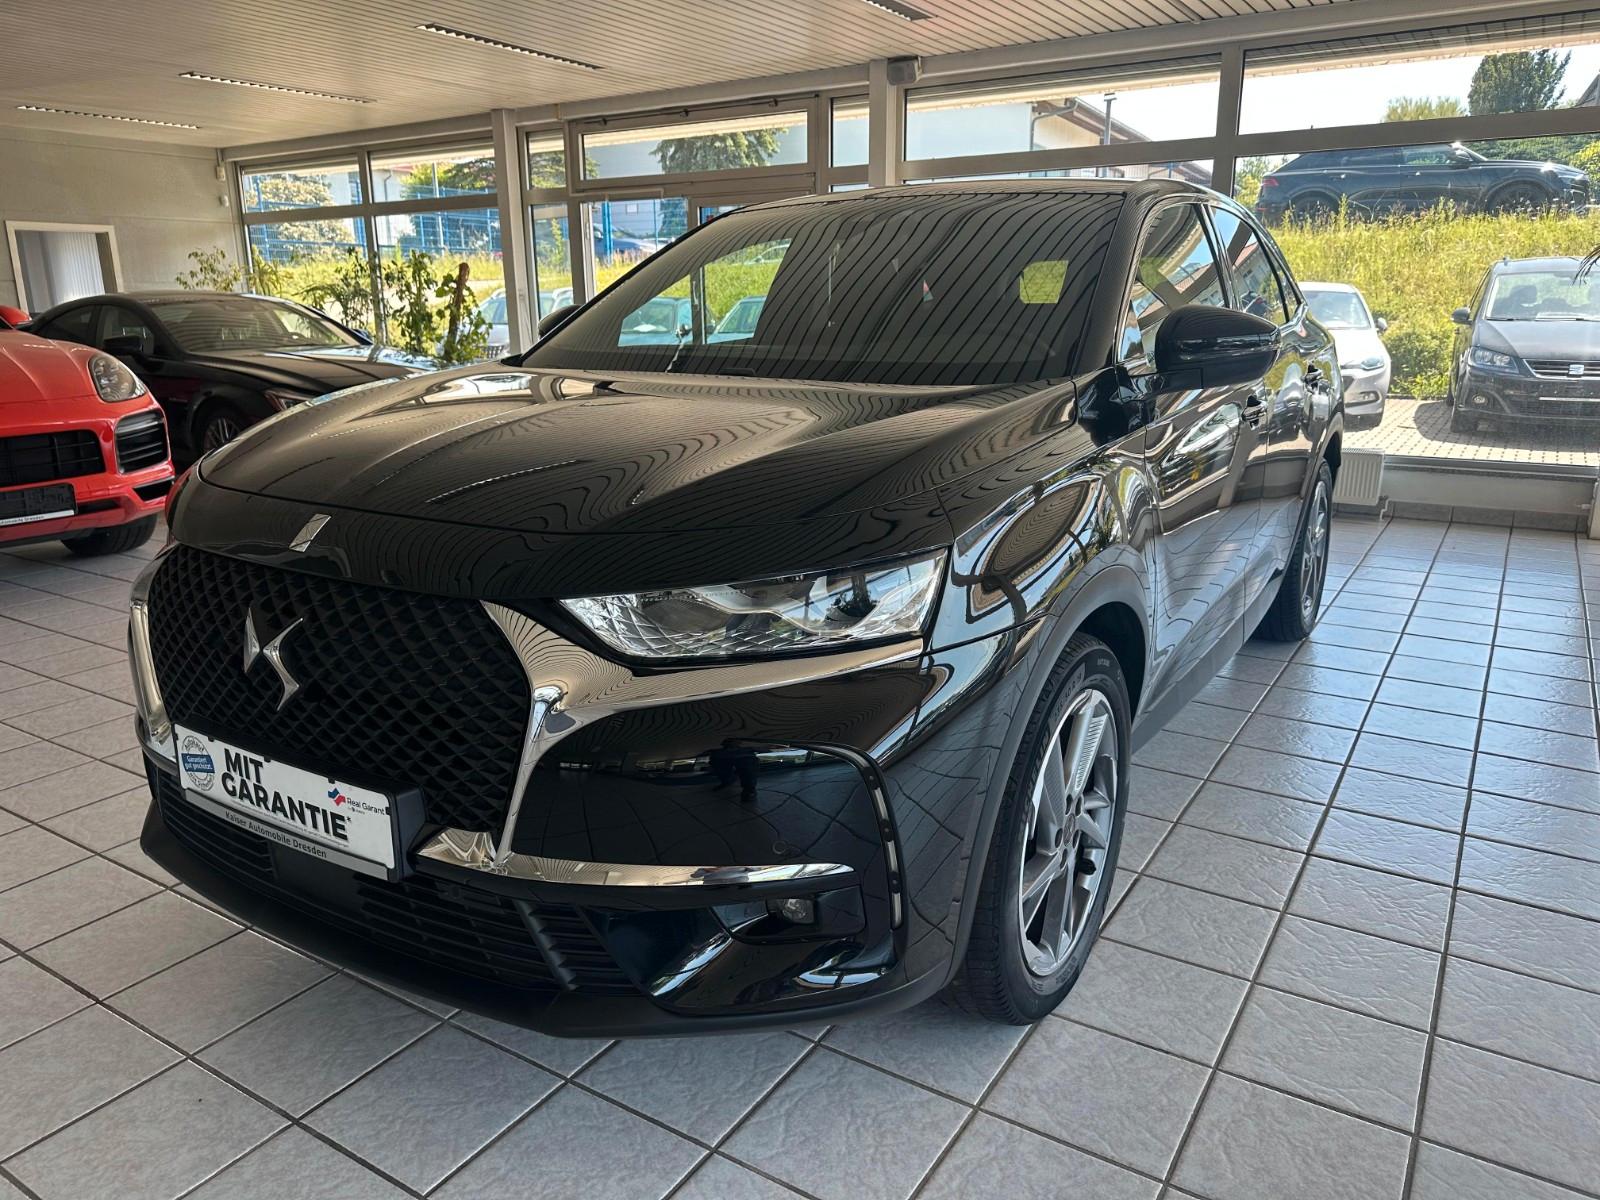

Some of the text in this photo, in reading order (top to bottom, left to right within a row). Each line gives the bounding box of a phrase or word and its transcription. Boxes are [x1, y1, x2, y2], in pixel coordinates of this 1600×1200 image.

[224, 748, 264, 784] MIT
[347, 797, 361, 808] Real
[361, 802, 386, 815] Garant
[225, 811, 327, 858] Kaiser Automobile Dresden
